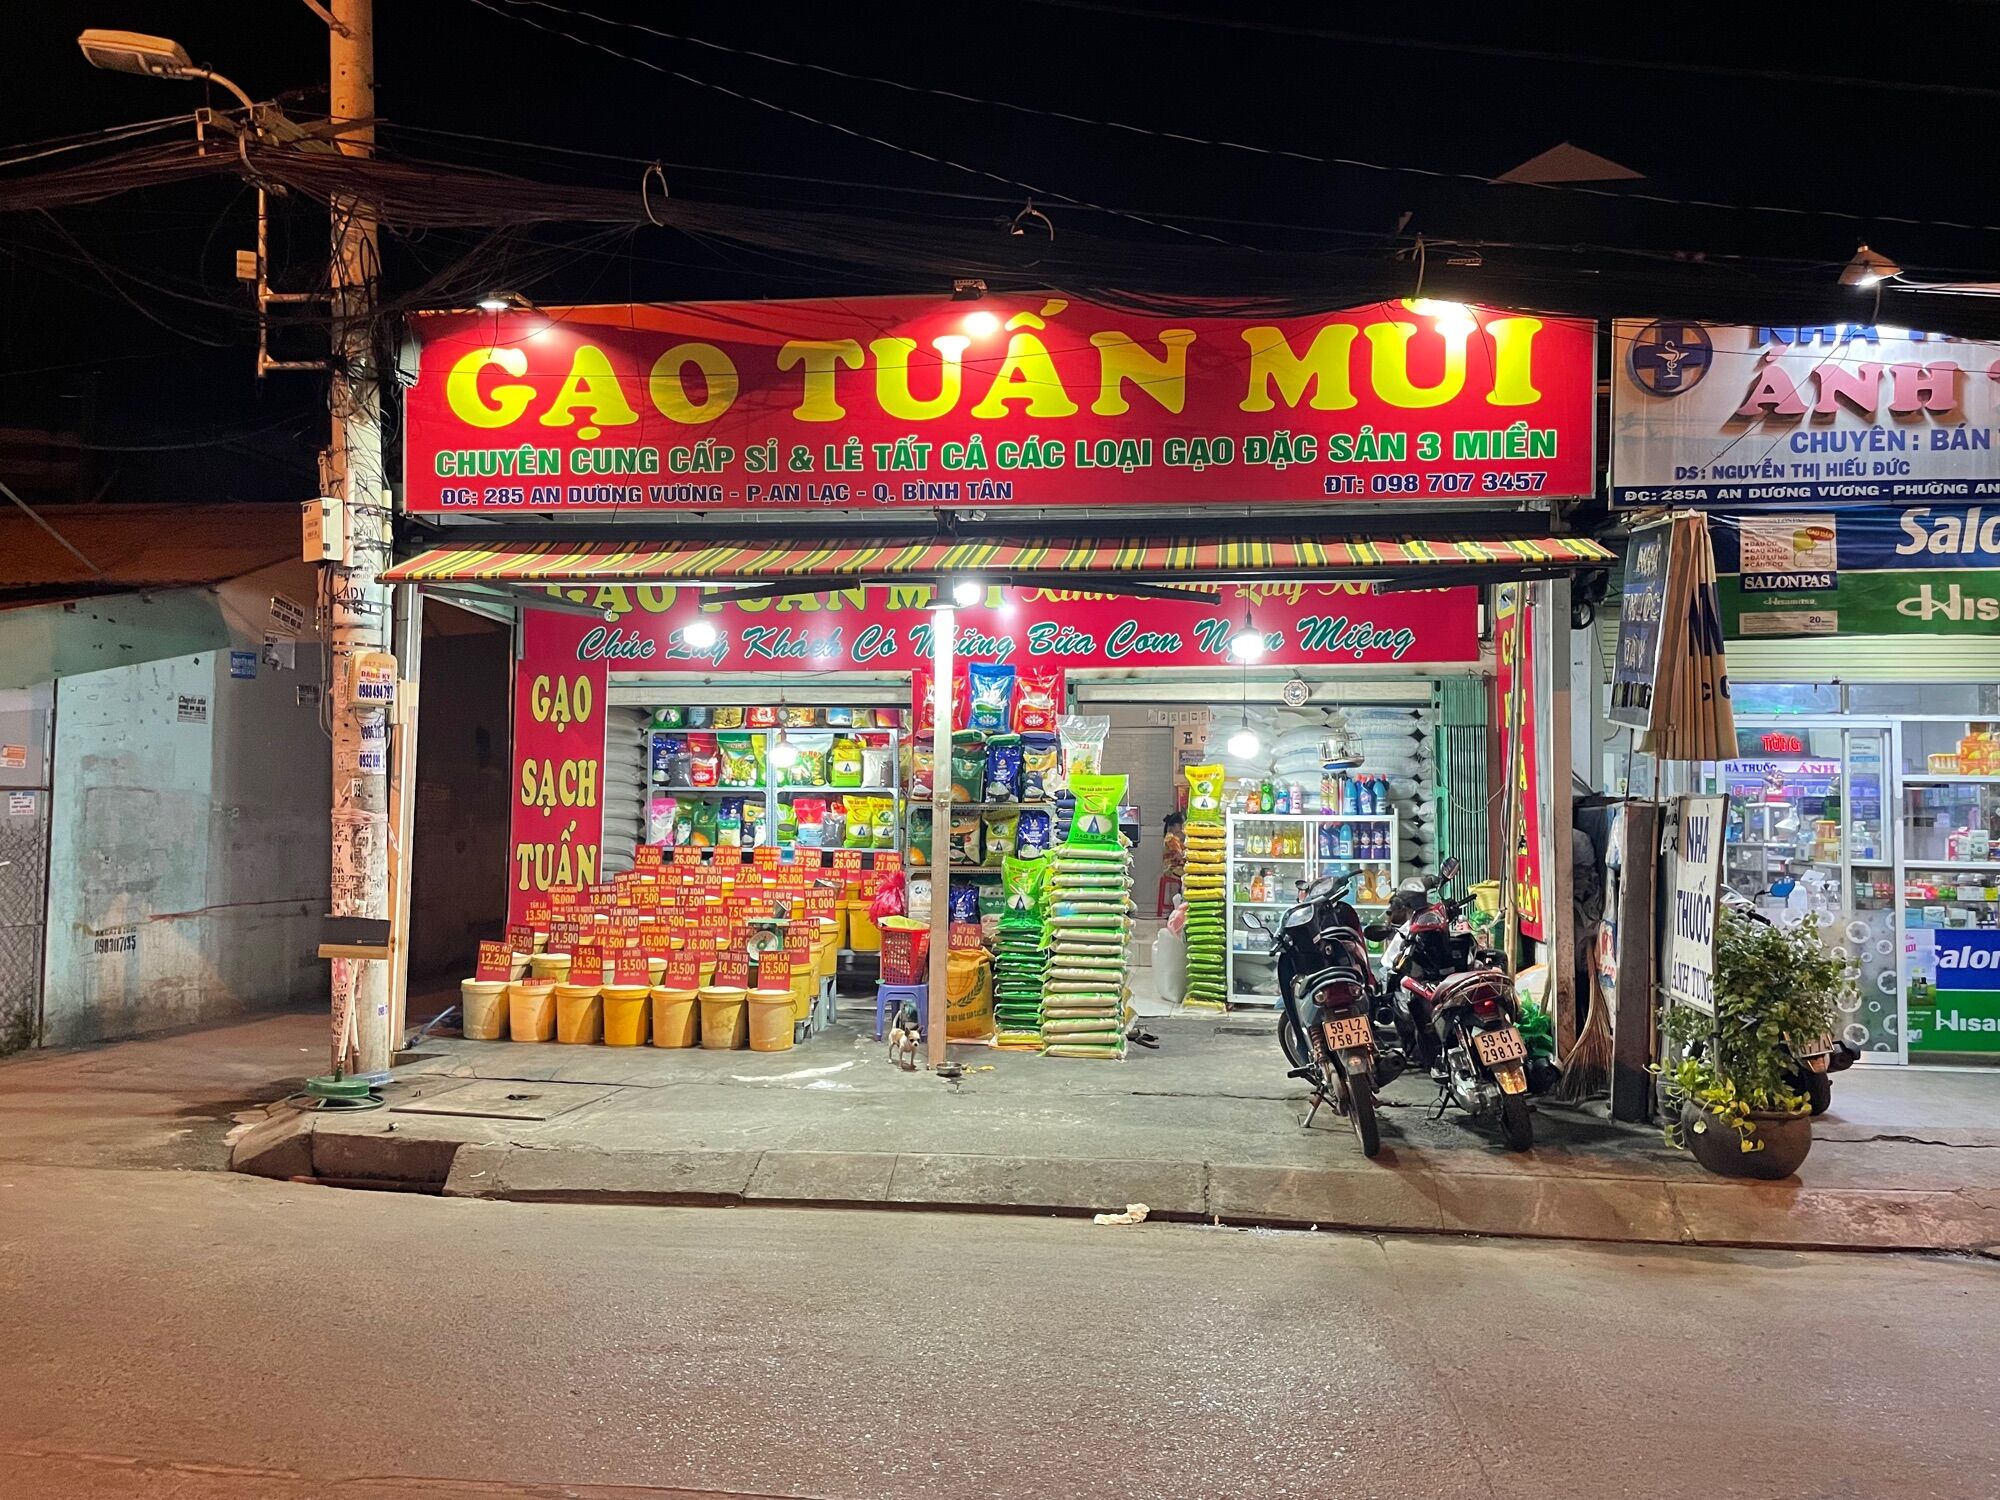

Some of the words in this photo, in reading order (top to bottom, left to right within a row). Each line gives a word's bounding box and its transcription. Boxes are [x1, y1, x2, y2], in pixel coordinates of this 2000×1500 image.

[447, 343, 739, 440] GẠO
[777, 298, 1196, 421] TUẤN
[1736, 345, 1959, 416] ÁNH
[1931, 423, 1990, 451] BÁN
[435, 444, 560, 477] CHUYÊN
[570, 447, 659, 475] CUNG
[669, 438, 735, 474] CẤP
[745, 438, 778, 472] SỈ
[788, 445, 814, 472] &
[825, 436, 863, 471] LẺ
[872, 435, 931, 471] TẤT
[941, 434, 987, 470] CẢ
[996, 435, 1064, 469] CÁC
[1075, 439, 1152, 473] LOẠI
[1163, 437, 1234, 472] GẠO
[1243, 430, 1317, 470] ĐẶC
[1329, 425, 1406, 461] SẢN
[1417, 432, 1441, 461] 3
[1454, 421, 1557, 459] MIỀN
[1675, 466, 1706, 480] DS:
[1712, 458, 1784, 480] NGUYỄN
[1791, 463, 1820, 480] THỊ
[1826, 457, 1866, 476] HIẾU
[1873, 457, 1910, 476] ĐỨC
[1324, 475, 1364, 494] ĐT:
[1372, 474, 1419, 493] 098
[1426, 473, 1475, 492] 707
[1482, 471, 1548, 491] 3457
[441, 488, 478, 505] ĐC:
[484, 487, 524, 504] 285
[530, 487, 560, 504] AN
[567, 484, 642, 504] DƯƠNG
[649, 483, 723, 503] VƯƠNG
[746, 483, 800, 502] P.AN
[807, 483, 850, 505] LẠC
[872, 483, 895, 503] Q.
[902, 479, 959, 500] BÌNH
[967, 478, 1013, 500] TÂN
[1625, 491, 1657, 502] ĐC:
[1661, 489, 1707, 500] 285A
[1717, 488, 1741, 499] AN
[1749, 486, 1811, 498] DƯƠNG
[1818, 485, 1879, 497] VƯƠNG
[1894, 481, 1968, 495] PHƯỜNG
[1975, 483, 2000, 494] AN
[1745, 574, 1831, 589] SALONPAS
[1809, 616, 1821, 624] 20
[576, 625, 656, 663] Chúc
[742, 623, 842, 664] Khách
[851, 624, 898, 663] Có
[908, 623, 1017, 665] Nững
[1027, 621, 1097, 656] Bữa
[1106, 619, 1183, 660] Cơm
[1194, 618, 1285, 662] Nn
[1298, 614, 1416, 660] Miệng
[531, 674, 592, 734] GẠO
[1796, 762, 1835, 773] ÁNH
[521, 758, 597, 818] SẠCH
[1687, 803, 1710, 863] NHÀ
[516, 820, 597, 892] TUẤN
[636, 854, 661, 865] 24.000
[674, 854, 701, 865] 26.000
[715, 856, 740, 866] 23.000
[834, 859, 860, 870] 26.000
[658, 875, 681, 885] 18.500
[695, 875, 721, 885] 21.000
[736, 873, 761, 884] 27.000
[778, 873, 803, 884] 26.000
[552, 894, 576, 905] 16.000
[590, 894, 616, 905] 18.000
[632, 893, 659, 904] 17.500
[677, 896, 705, 907] 17.500
[806, 899, 834, 910] 18.000
[525, 910, 551, 921] 13.500
[1677, 876, 1711, 945] THUỐC
[701, 915, 728, 926] 16.500
[508, 934, 533, 948] 15.500
[550, 932, 578, 944] 14.500
[597, 936, 625, 948] 14.500
[642, 935, 670, 947] 16.000
[784, 937, 808, 949] 6.000
[951, 934, 980, 947] 30.000
[686, 939, 715, 950] 16.000
[579, 948, 596, 956] 5451
[481, 953, 510, 967] 12.200
[573, 957, 601, 969] 14.500
[618, 959, 647, 971] 13.500
[668, 962, 696, 974] 13.500
[718, 961, 748, 975] 14.500
[760, 962, 789, 974] 15.500
[1672, 953, 1689, 993] ÁNH
[1692, 960, 1714, 1004] TÙNG
[1330, 1018, 1363, 1034] 59-L2
[1329, 1030, 1370, 1049] 758.73
[1481, 1029, 1513, 1048] 59-G1
[1482, 1042, 1523, 1063] 298.13
